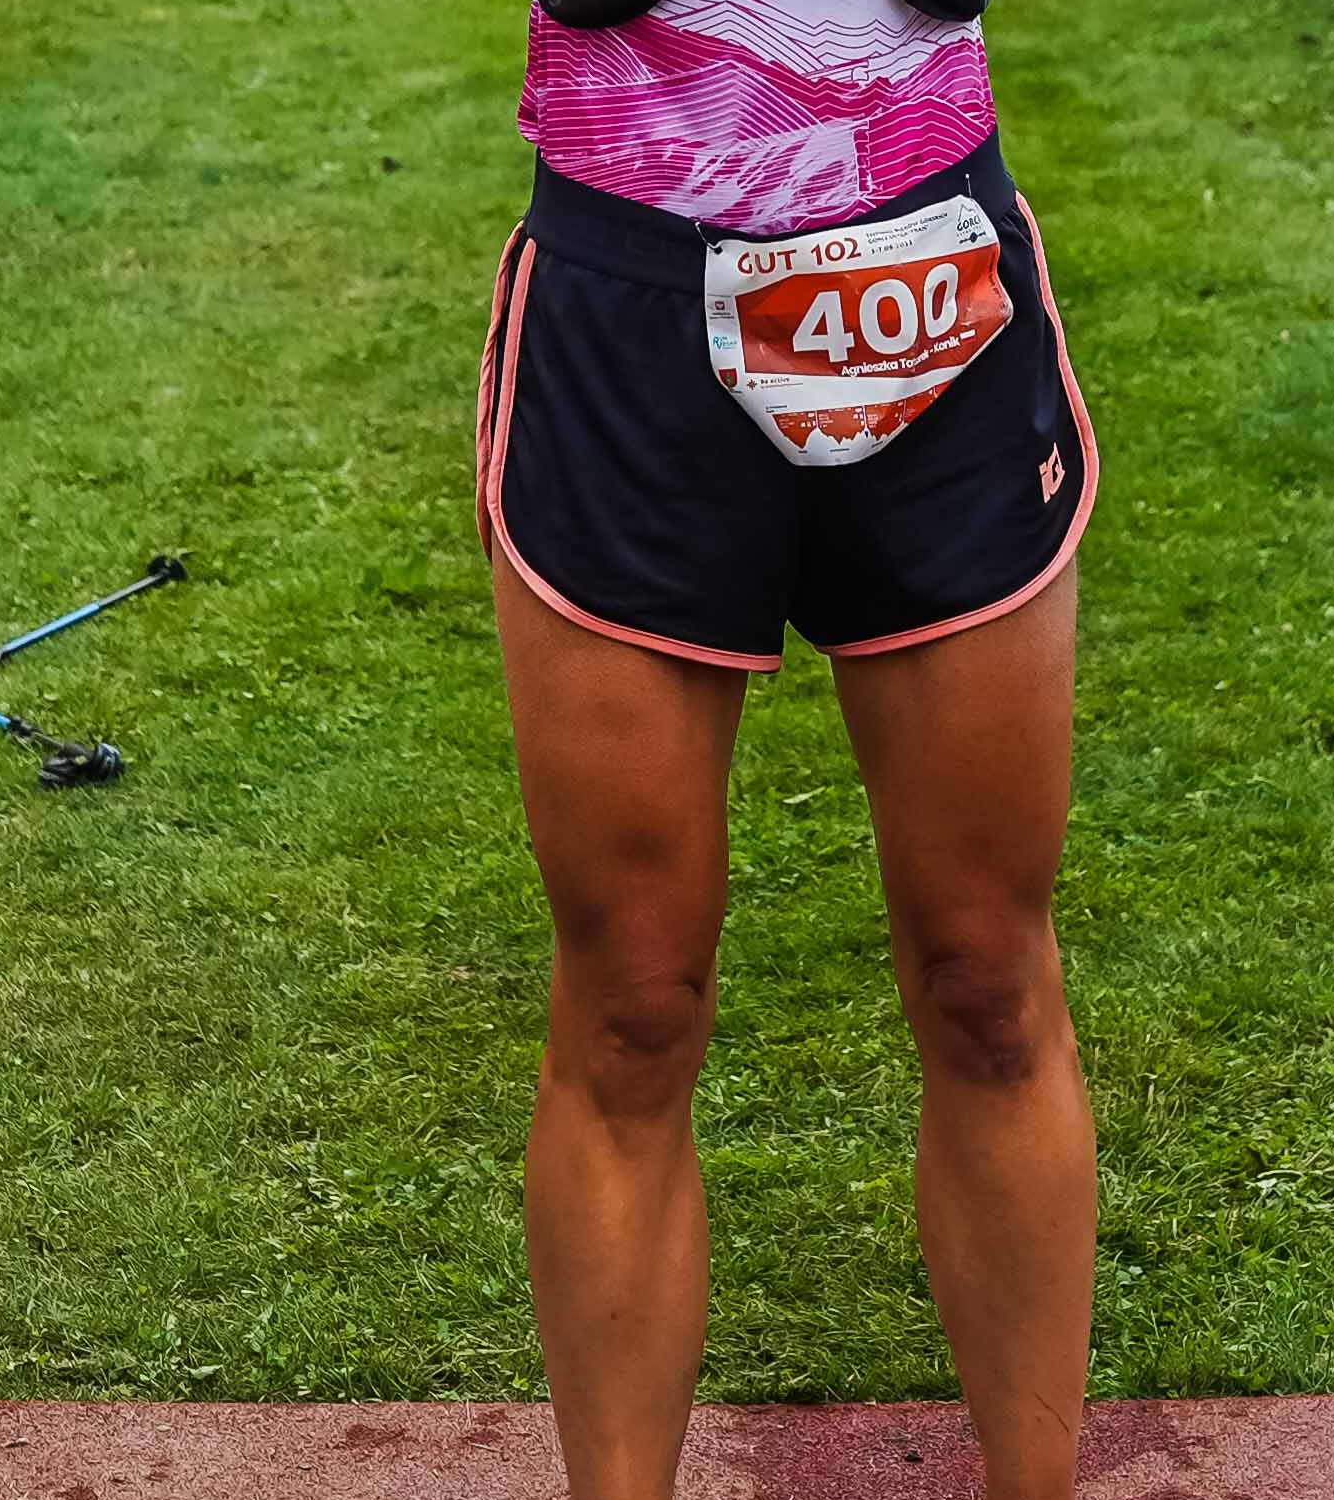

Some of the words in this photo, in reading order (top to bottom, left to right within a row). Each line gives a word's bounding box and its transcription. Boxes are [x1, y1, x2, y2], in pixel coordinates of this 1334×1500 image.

[737, 249, 797, 275] GUT
[811, 237, 861, 265] 102
[791, 262, 959, 363] 400
